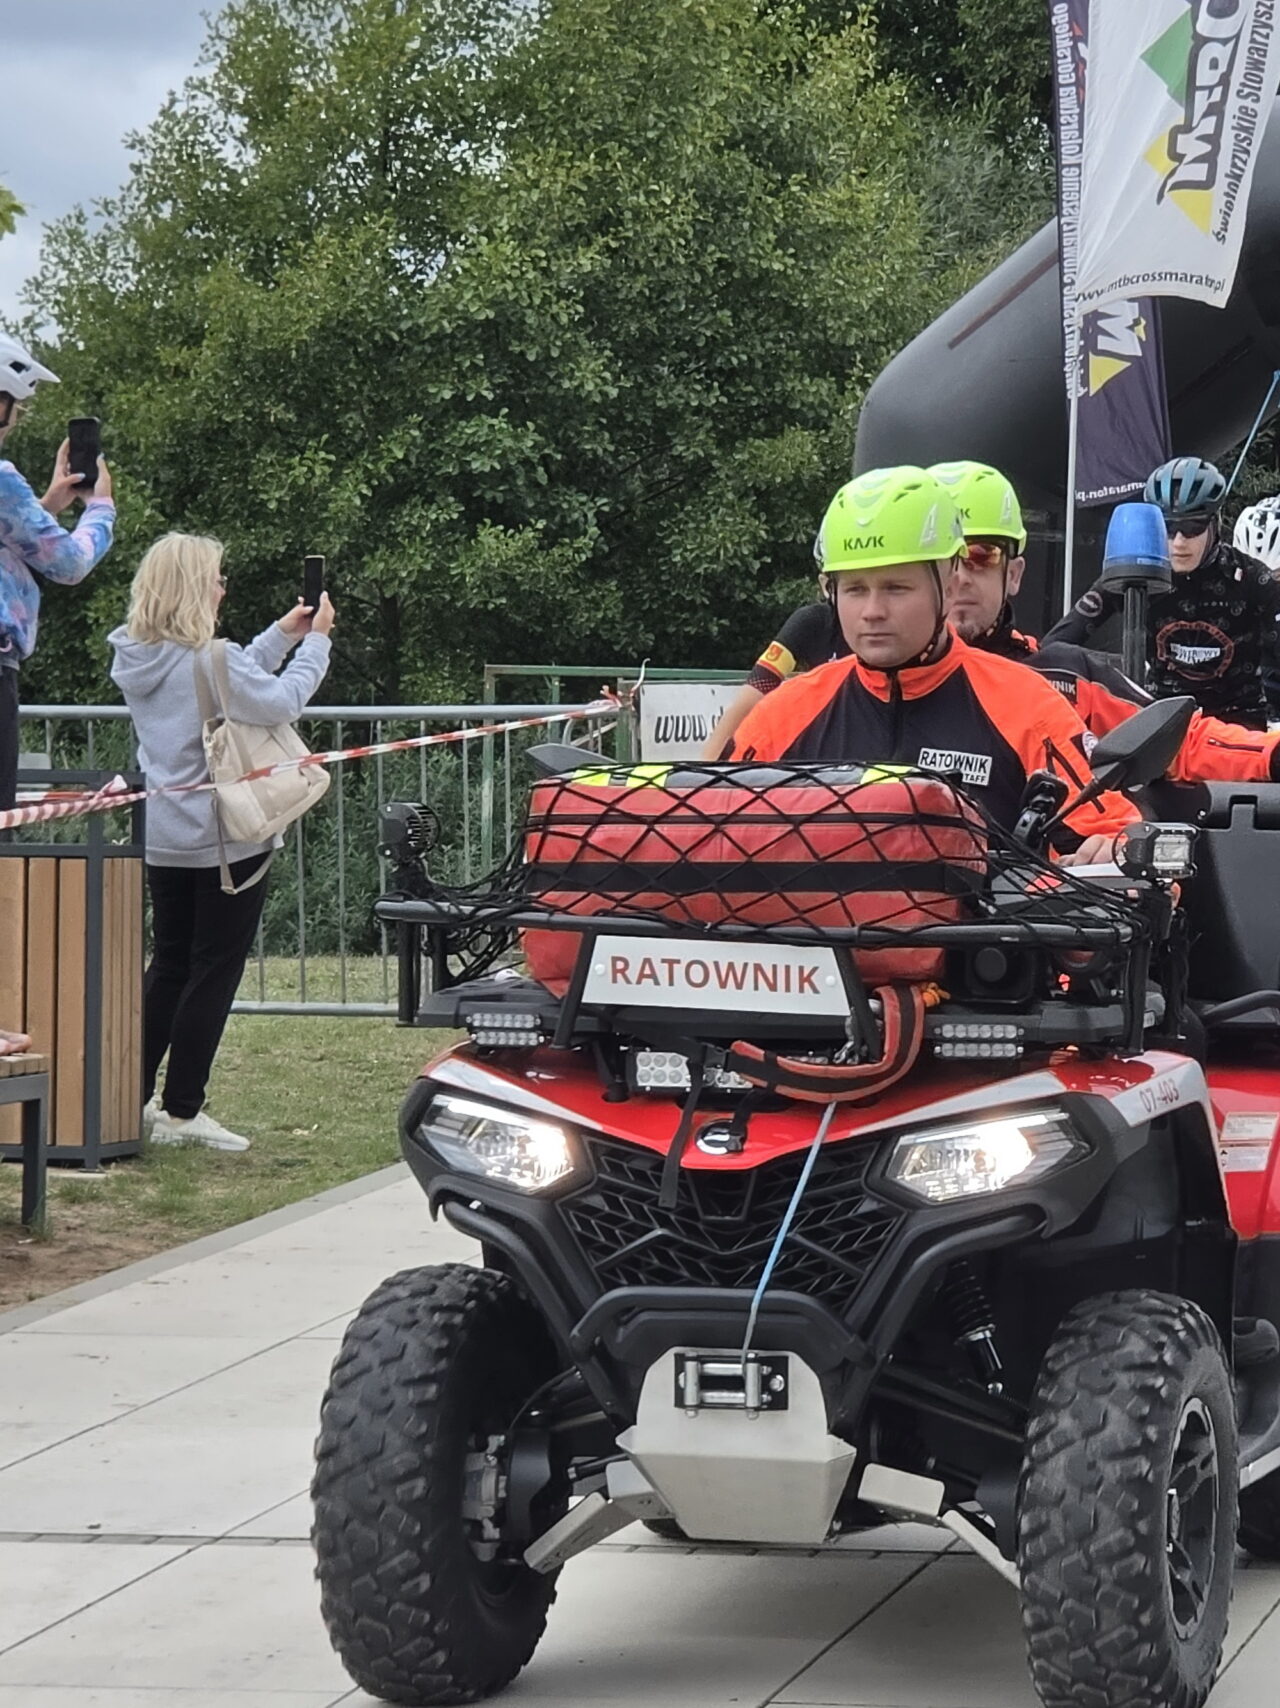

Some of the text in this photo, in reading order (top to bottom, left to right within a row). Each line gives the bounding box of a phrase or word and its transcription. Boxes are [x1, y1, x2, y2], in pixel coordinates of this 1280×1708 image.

[1236, 0, 1276, 100] Stowarzysz
[919, 750, 989, 774] RATOWNIK
[964, 773, 987, 783] TAFF
[609, 955, 822, 995] RATOWNIK
[1139, 1078, 1180, 1113] 07-403
